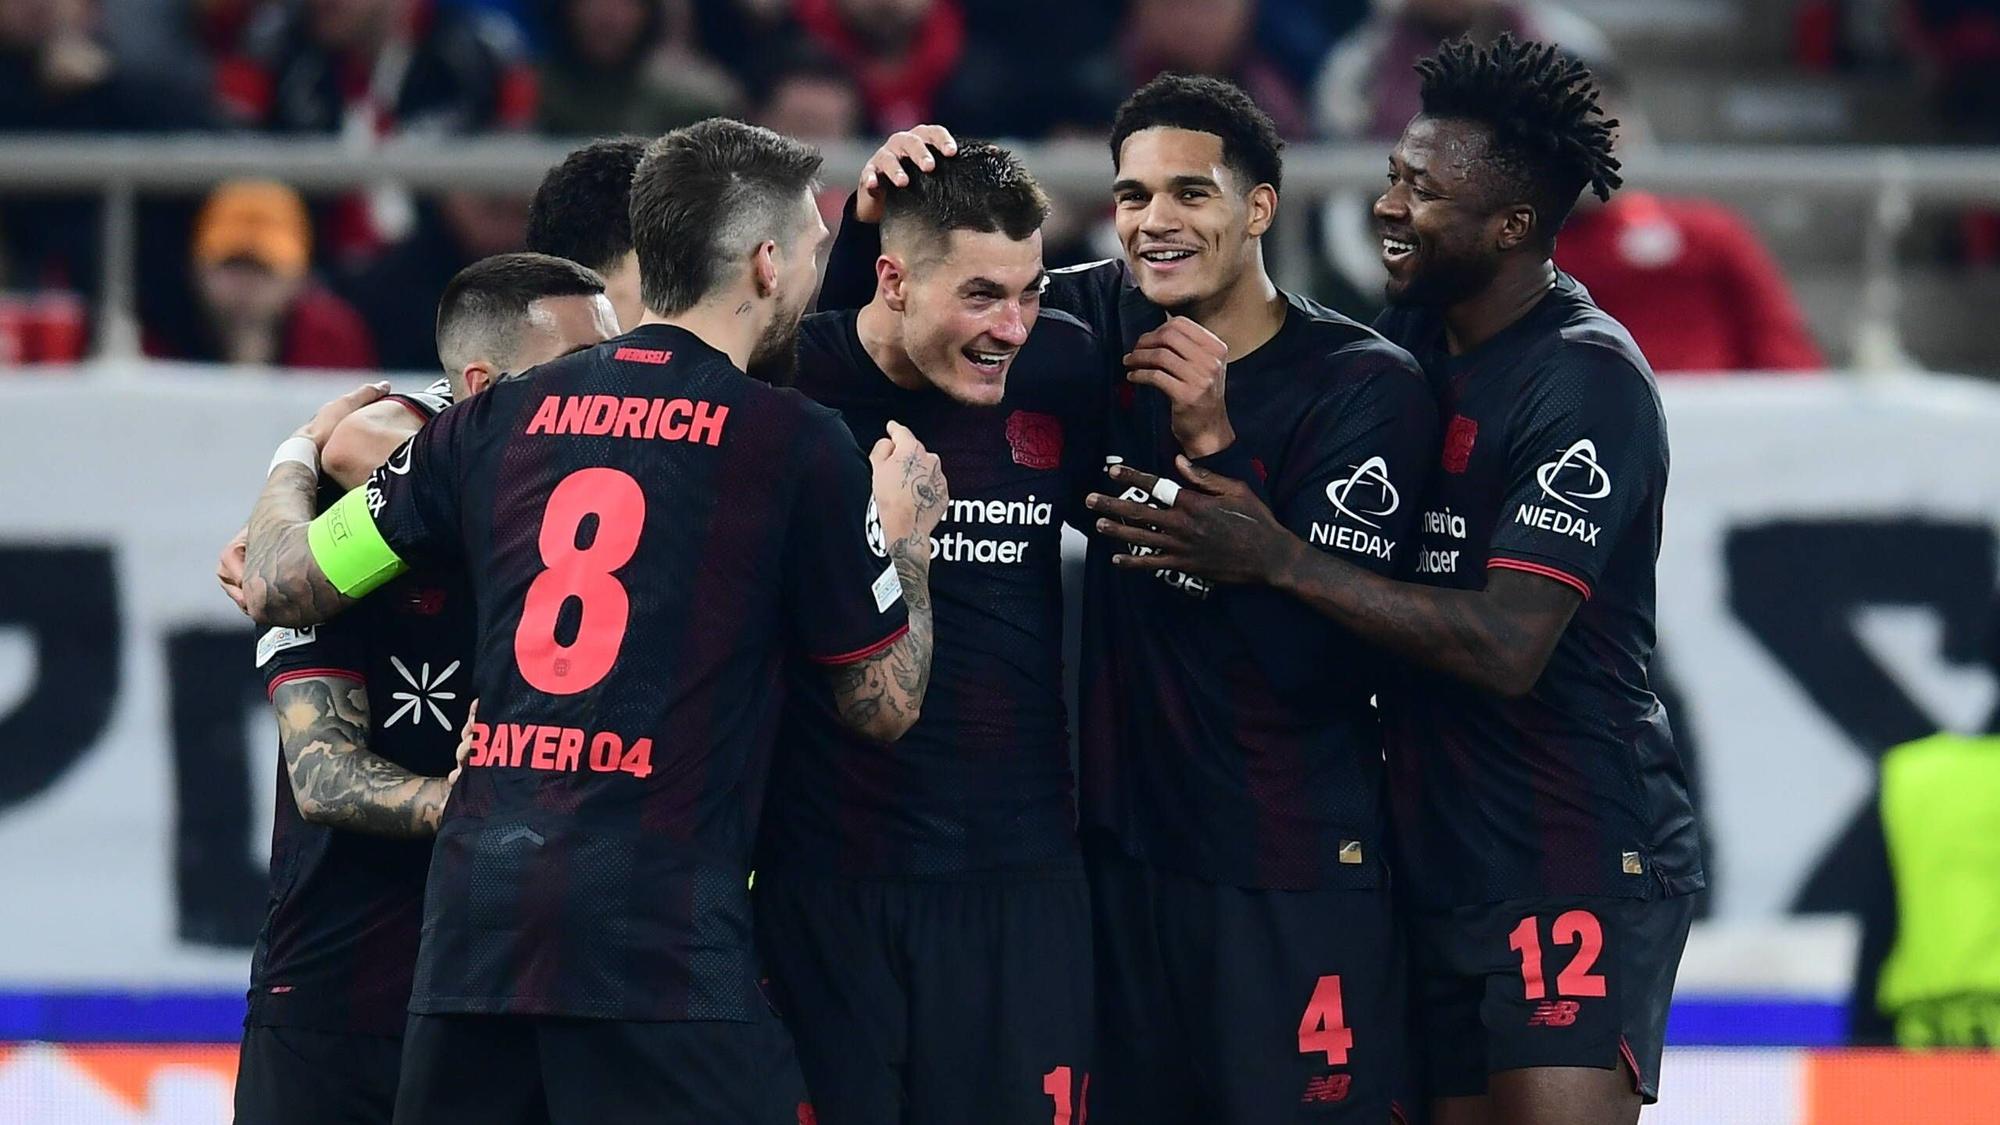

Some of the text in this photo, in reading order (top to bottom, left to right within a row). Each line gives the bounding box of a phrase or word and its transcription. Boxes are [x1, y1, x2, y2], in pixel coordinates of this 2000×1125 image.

[527, 395, 729, 446] ANDRICH
[941, 494, 1053, 526] rmenia
[1515, 503, 1602, 547] NIEDAX
[929, 531, 1029, 563] othaer
[1309, 521, 1396, 562] NIEDAX
[514, 467, 646, 695] 8
[469, 723, 653, 778] BAYER 04
[1509, 910, 1607, 999] 12
[1299, 975, 1353, 1065] 4
